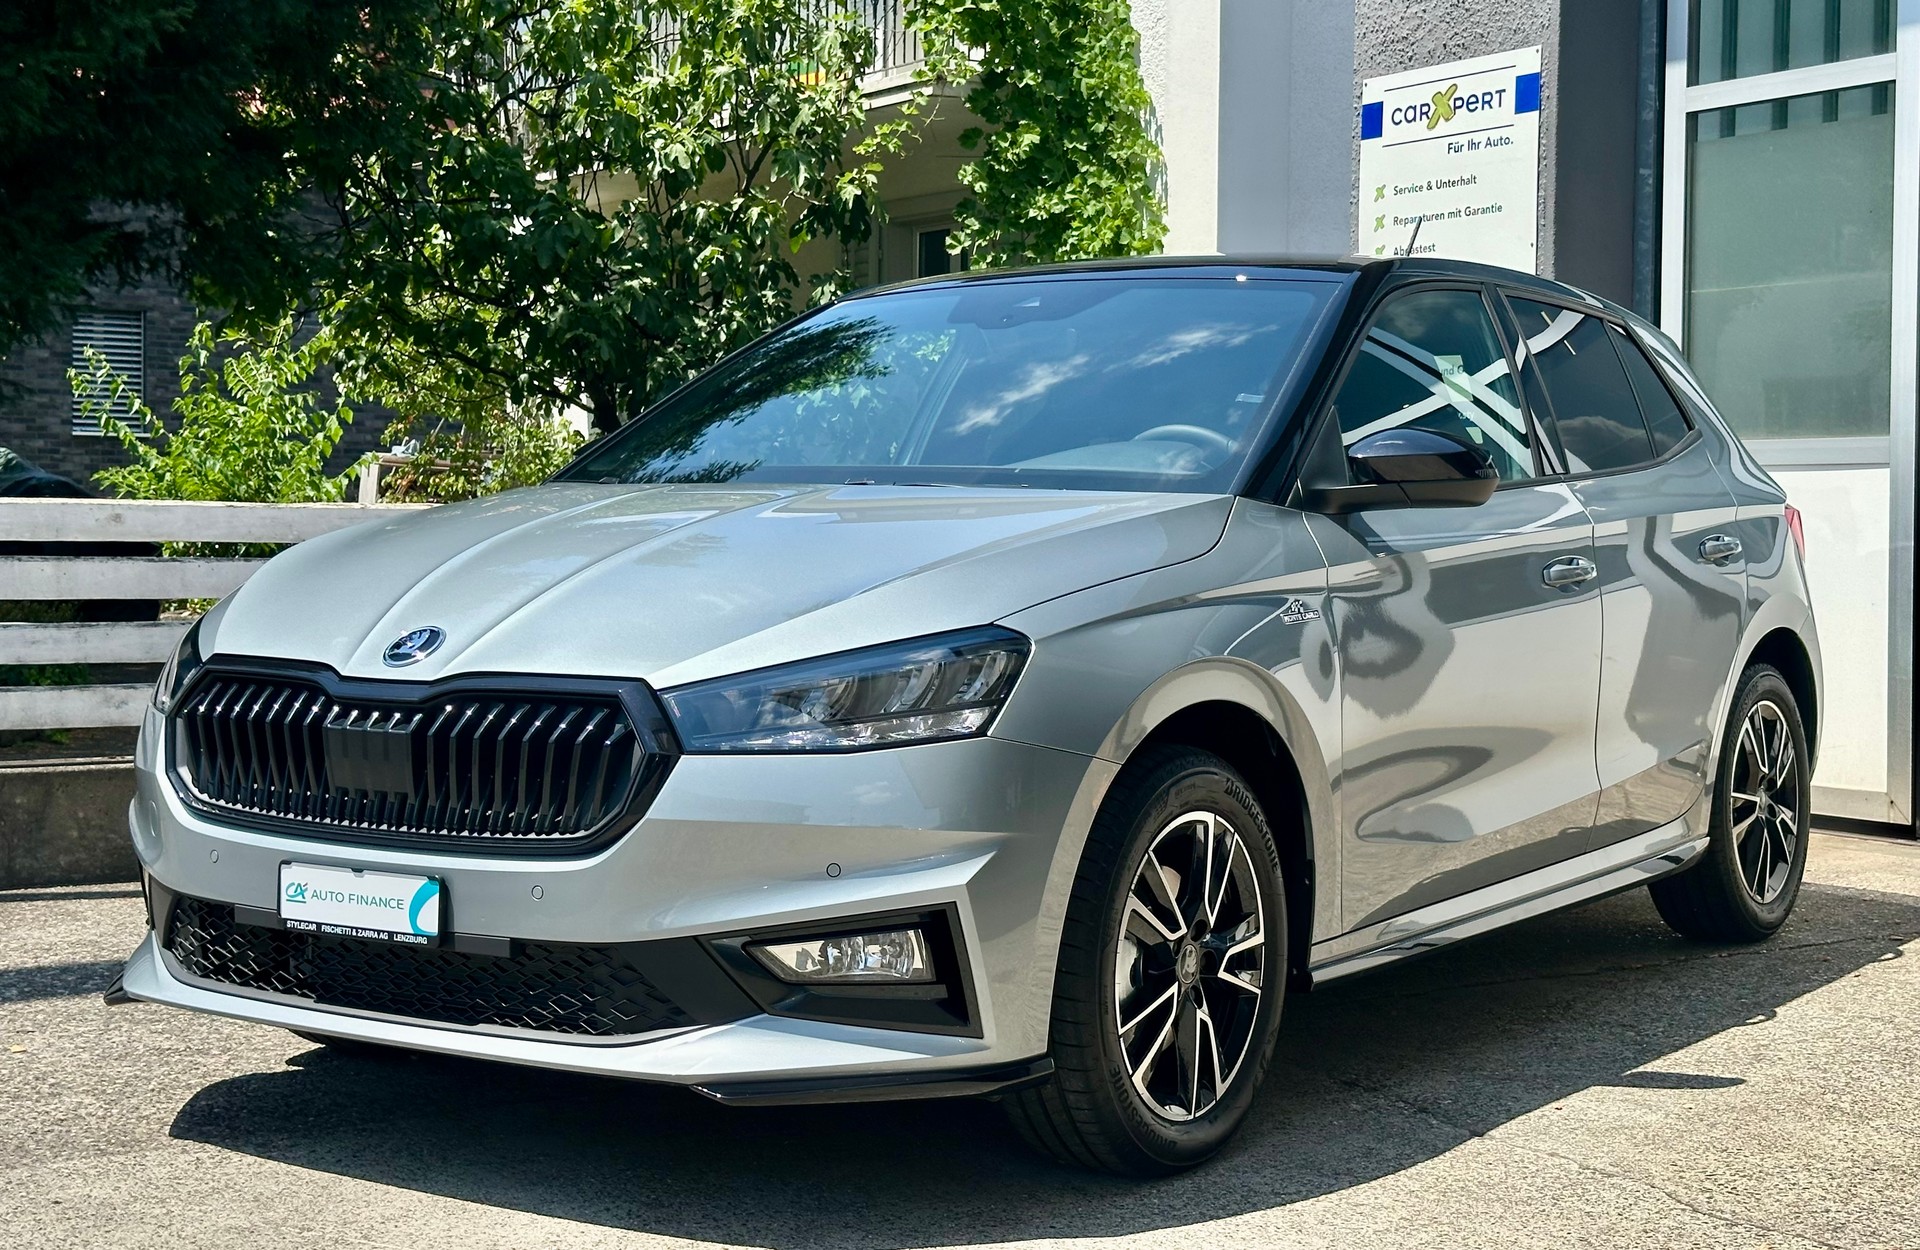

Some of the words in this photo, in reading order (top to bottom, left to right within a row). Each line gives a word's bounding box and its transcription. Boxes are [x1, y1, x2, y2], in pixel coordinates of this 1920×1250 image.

[1447, 141, 1464, 155] Für
[1467, 138, 1481, 152] Ihr
[1484, 136, 1514, 149] Auto.
[1393, 183, 1424, 196] Service
[1426, 180, 1433, 191] &
[1435, 174, 1477, 190] Unterhalt
[1447, 207, 1462, 219] mit
[1464, 202, 1503, 217] Garantie
[1223, 776, 1280, 874] BRIDGESTONE
[310, 889, 345, 903] AUTO
[348, 893, 404, 910] FINANCE
[286, 920, 317, 931] STYLECAR
[321, 925, 351, 936] FISCHETTI
[352, 928, 357, 936] &
[357, 929, 378, 939] ZARRA
[379, 932, 388, 940] AG
[393, 933, 428, 945] LENZBURG
